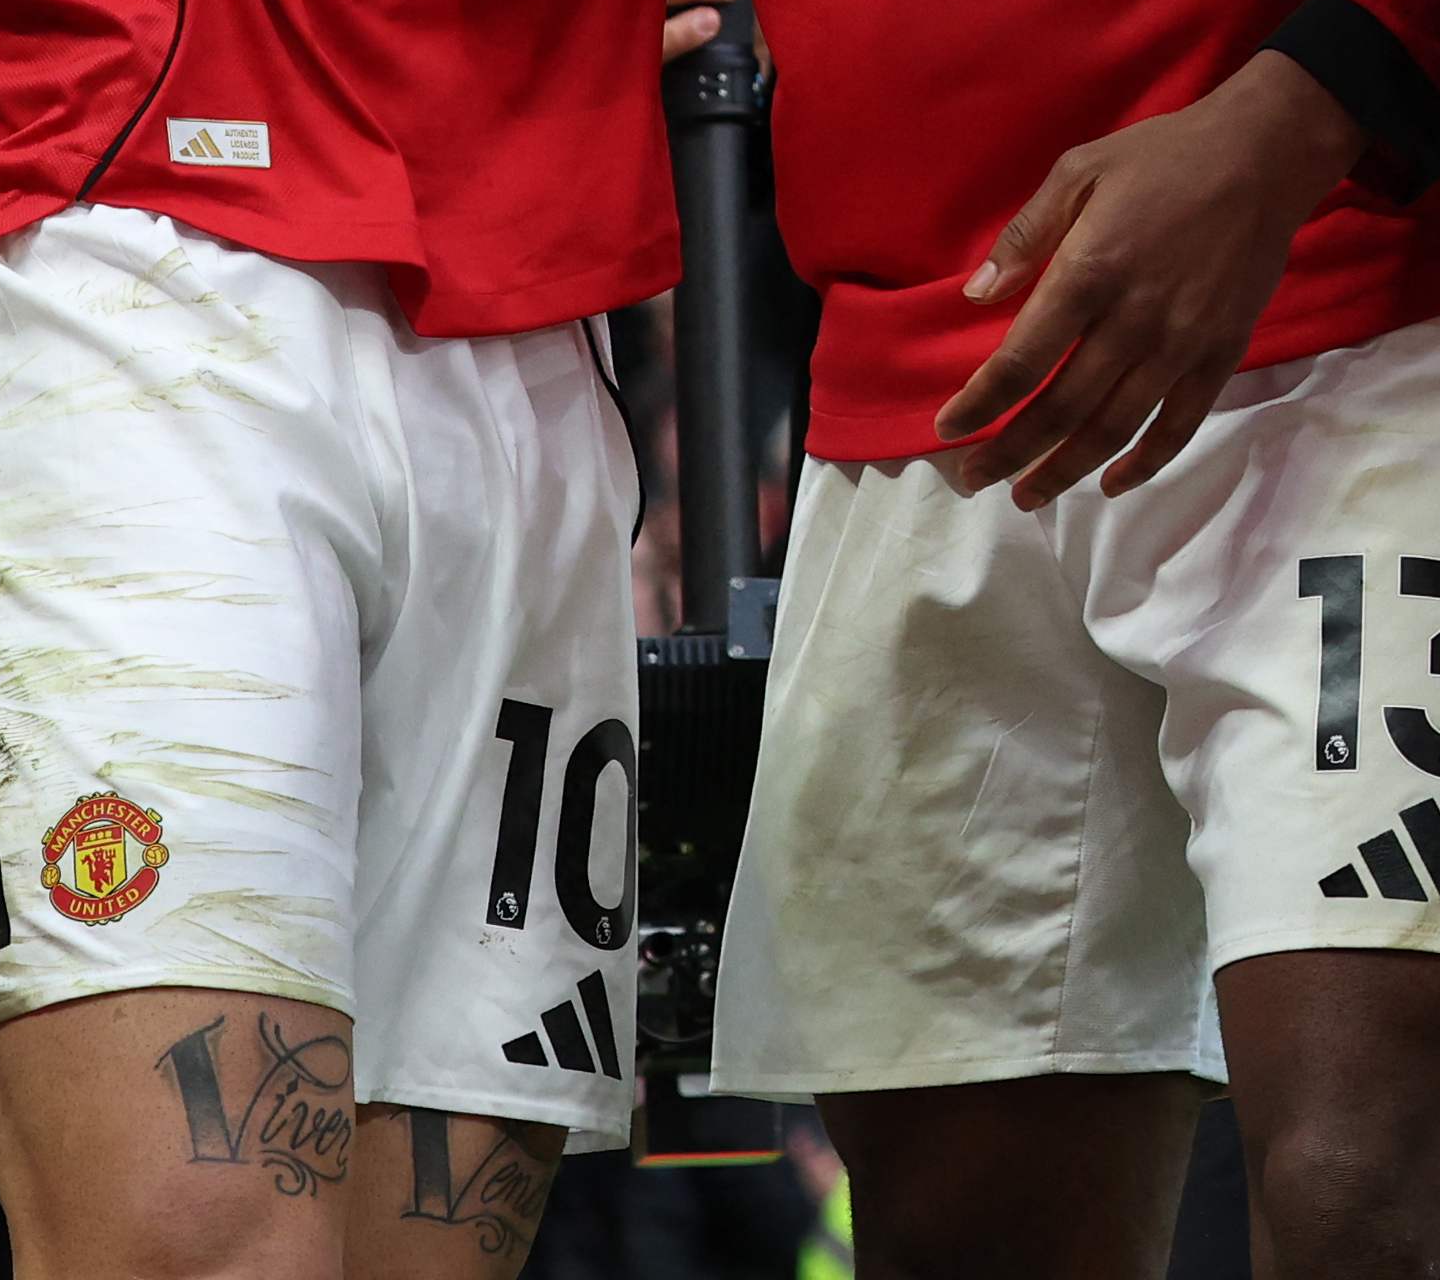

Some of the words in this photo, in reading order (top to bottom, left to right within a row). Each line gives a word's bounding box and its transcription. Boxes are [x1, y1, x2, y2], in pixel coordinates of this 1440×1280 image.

[50, 802, 152, 853] MANCHESTER
[486, 698, 637, 951] 10
[69, 887, 141, 916] UNITED
